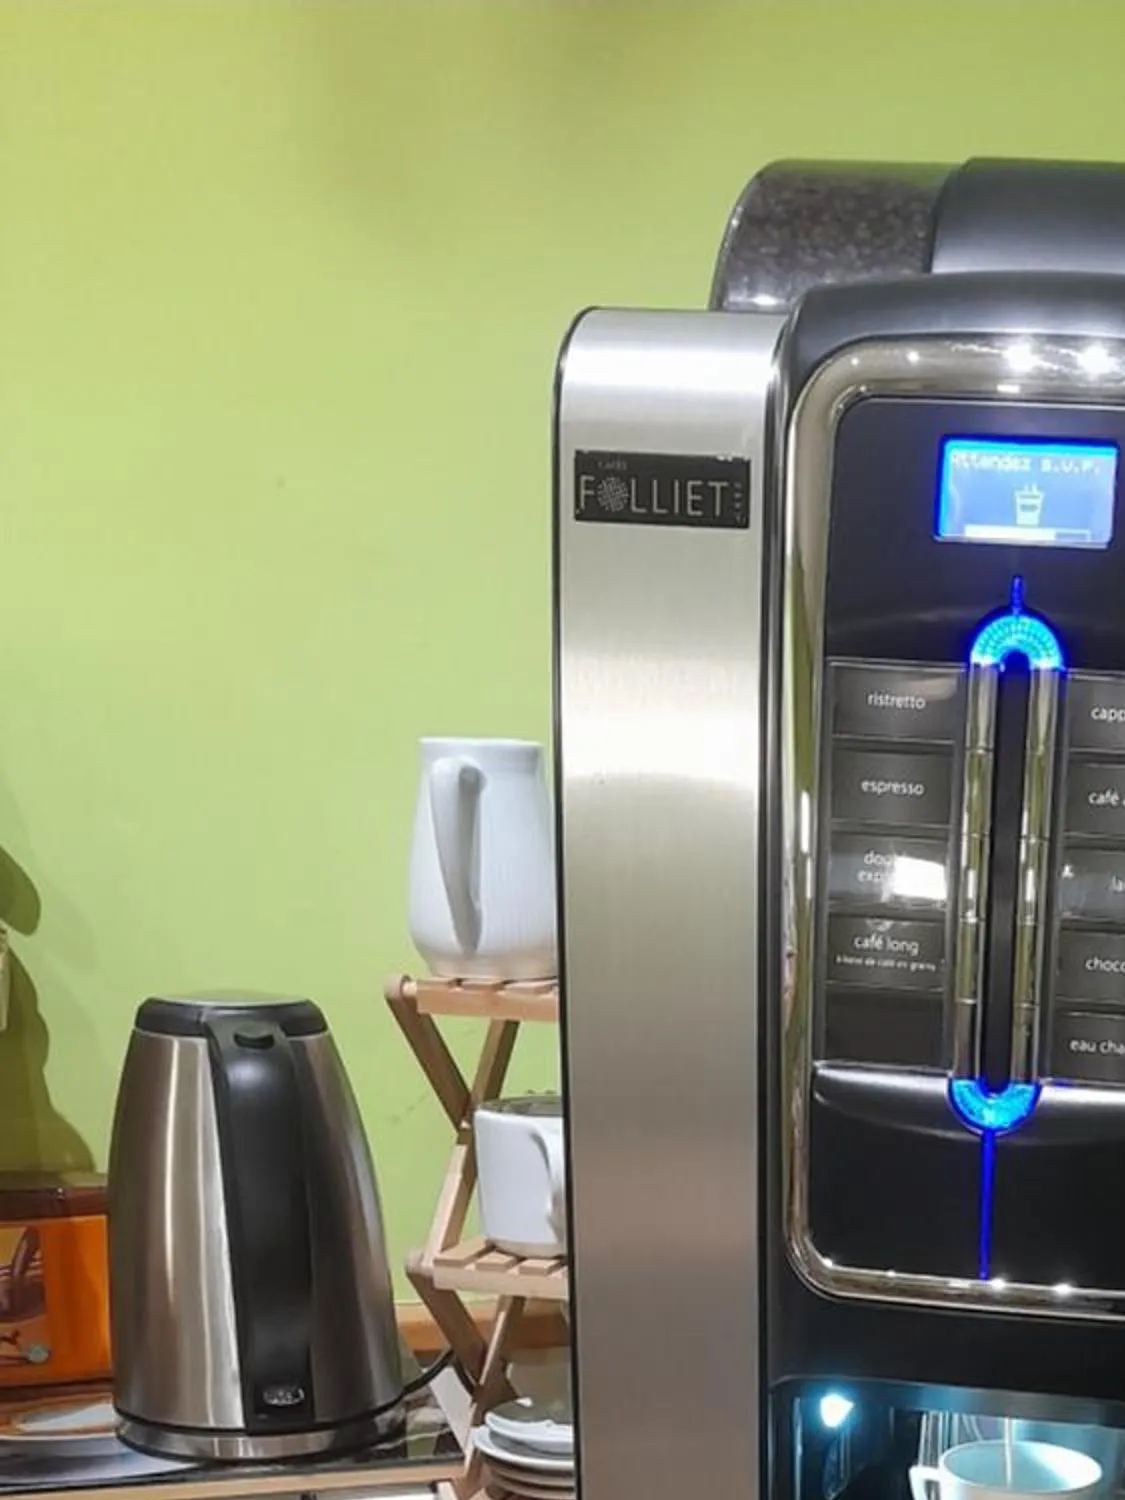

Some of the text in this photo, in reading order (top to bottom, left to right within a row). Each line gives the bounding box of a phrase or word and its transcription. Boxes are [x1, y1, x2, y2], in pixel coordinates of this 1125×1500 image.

[867, 691, 926, 710] ristretto
[861, 779, 925, 796] espresso
[1088, 791, 1119, 807] café
[854, 932, 919, 956] café long
[1070, 1040, 1097, 1053] eau
